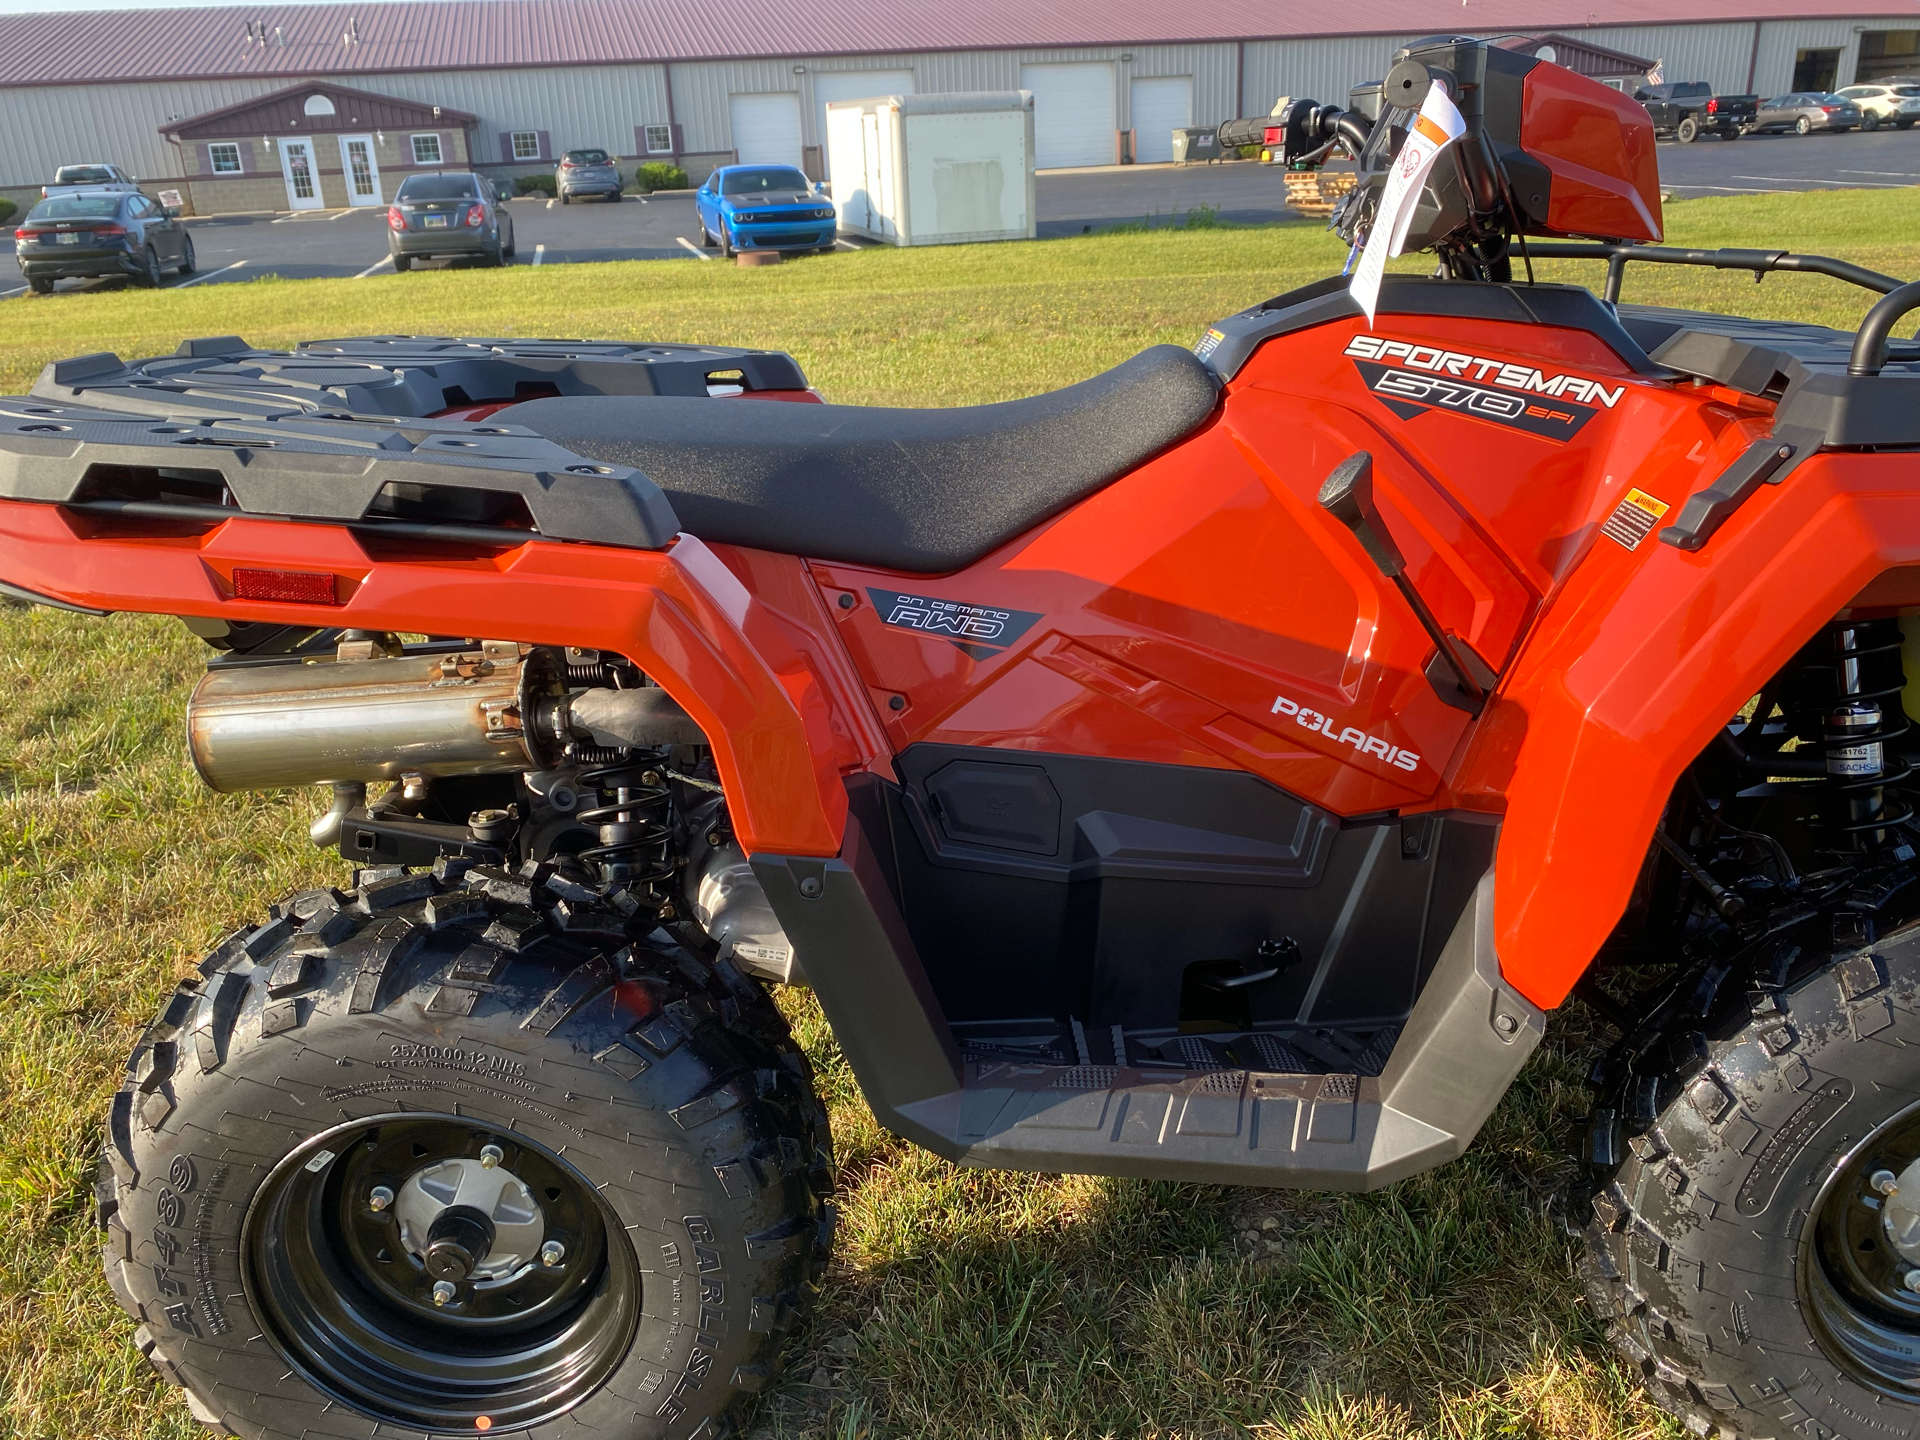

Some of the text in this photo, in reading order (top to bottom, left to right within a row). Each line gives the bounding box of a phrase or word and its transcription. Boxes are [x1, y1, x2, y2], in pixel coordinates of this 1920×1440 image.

[1343, 335, 1627, 409] SPORTSMAN
[1374, 369, 1575, 425] 570 EFI
[887, 605, 1004, 639] AWD
[897, 595, 1010, 620] ON DEMAND
[1271, 695, 1420, 772] POLARIS
[1839, 763, 1873, 772] SACHS
[372, 1060, 541, 1094] NOT FOR HIGHWAY SERVICE
[490, 1055, 528, 1077] NHS
[1770, 1120, 1819, 1175] TUBELESS
[672, 1279, 681, 1303] MADE
[656, 1215, 724, 1425] CARLISLE
[668, 1321, 680, 1337] THE
[672, 1307, 681, 1317] IN
